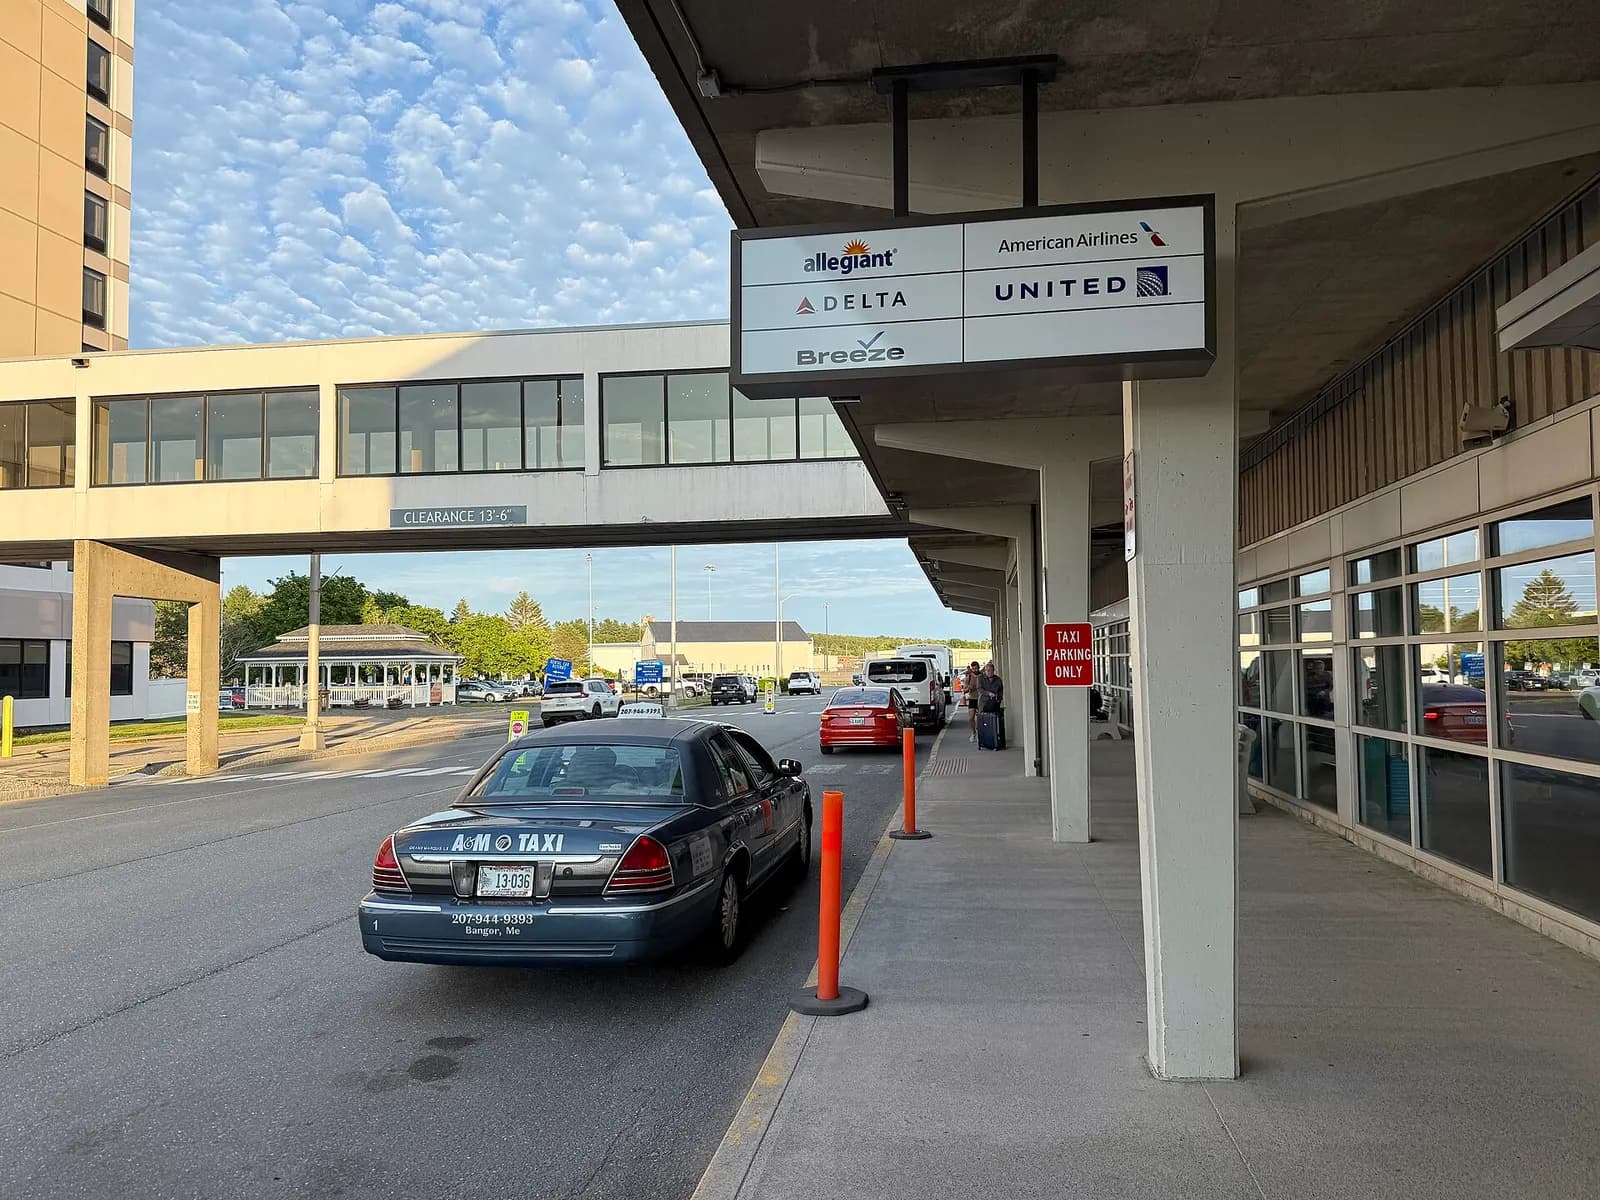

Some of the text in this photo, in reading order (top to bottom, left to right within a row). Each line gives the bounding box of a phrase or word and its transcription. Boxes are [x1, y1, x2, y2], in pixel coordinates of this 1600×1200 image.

[998, 230, 1138, 254] American Airlines
[803, 249, 894, 275] allegiant
[995, 276, 1127, 301] UNITED
[823, 291, 907, 312] DELTA
[797, 345, 905, 367] Breeze
[403, 510, 475, 524] CLEARANCE
[1056, 630, 1080, 643] TAXI
[1046, 648, 1091, 661] PARKING
[1055, 665, 1083, 678] ONLY
[452, 834, 564, 851] A&M TAXI
[372, 921, 379, 931] 1
[452, 914, 534, 925] 207-944-9393
[465, 926, 520, 936] Bangor, Me
